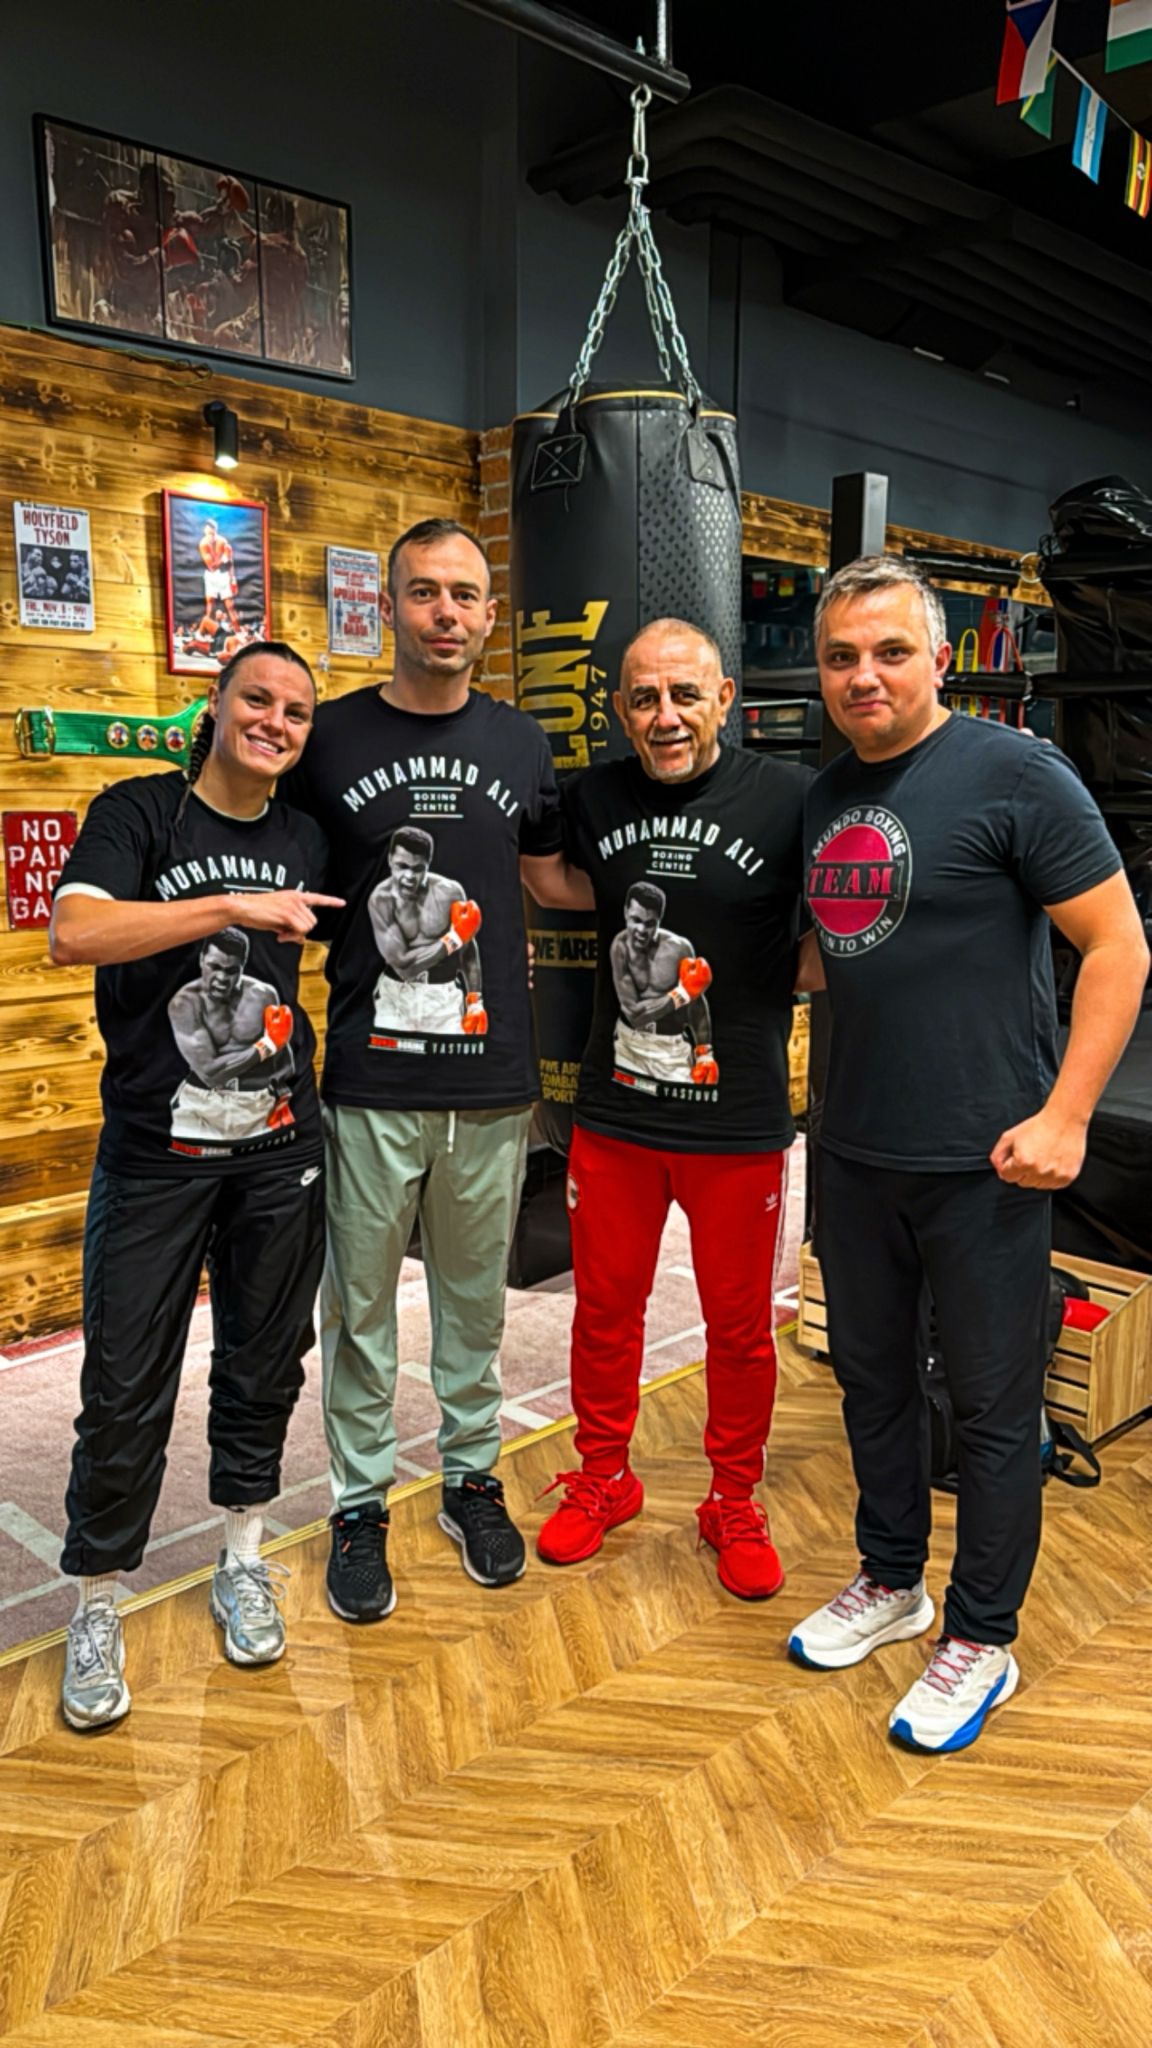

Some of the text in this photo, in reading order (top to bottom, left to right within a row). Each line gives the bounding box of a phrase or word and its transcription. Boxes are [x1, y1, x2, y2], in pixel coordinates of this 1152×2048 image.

[23, 510, 79, 531] HOLYFIELD
[34, 528, 70, 545] TYSON
[590, 665, 610, 752] 1947
[343, 756, 519, 818] MUHAMMAD ALI
[413, 793, 457, 802] BOXING
[413, 803, 457, 812] CENTER
[22, 819, 61, 843] NO
[812, 809, 906, 858] MUNDO BOXING
[598, 815, 764, 876] MUHAMMAD ALI
[651, 850, 693, 862] BOXING
[155, 854, 287, 902] MUHAMMAD
[651, 860, 692, 872] CENTER
[808, 867, 894, 895] TEAM
[840, 938, 857, 952] TO
[861, 915, 893, 946] WIN
